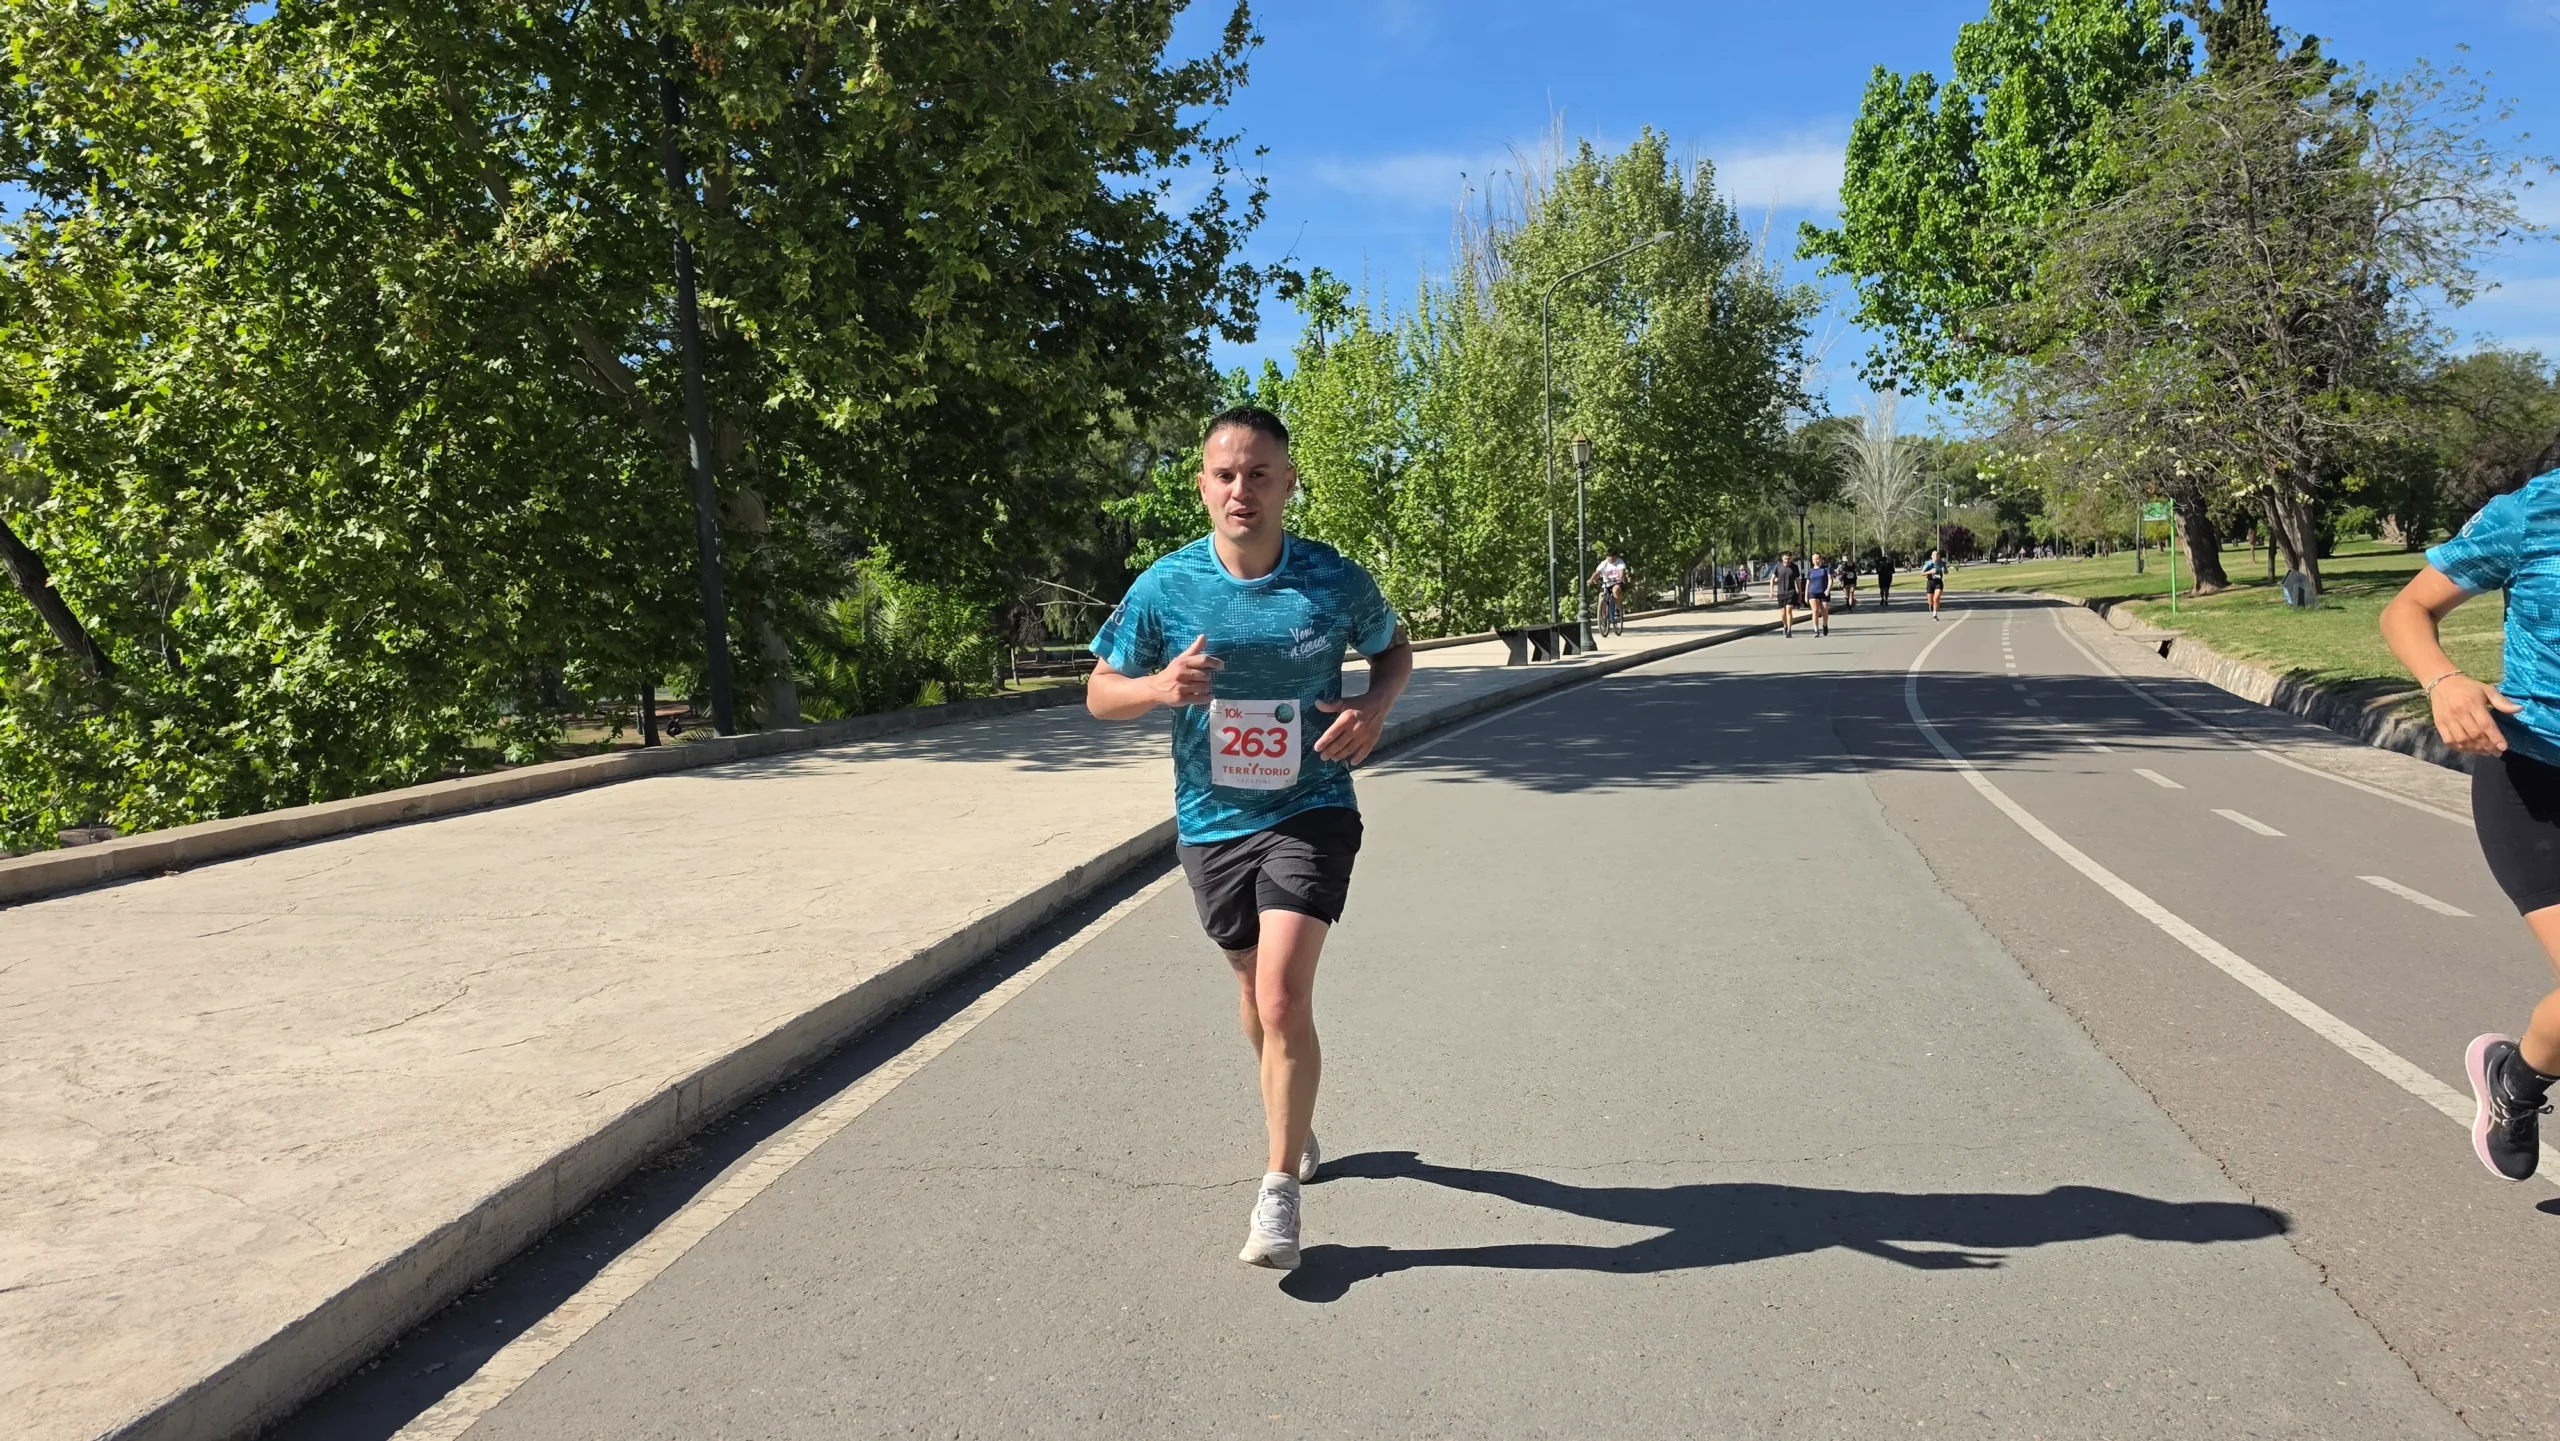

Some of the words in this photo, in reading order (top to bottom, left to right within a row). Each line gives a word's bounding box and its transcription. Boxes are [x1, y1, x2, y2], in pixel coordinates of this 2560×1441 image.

[1290, 646, 1299, 657] a
[1224, 708, 1243, 719] 10k
[1219, 726, 1288, 758] 263
